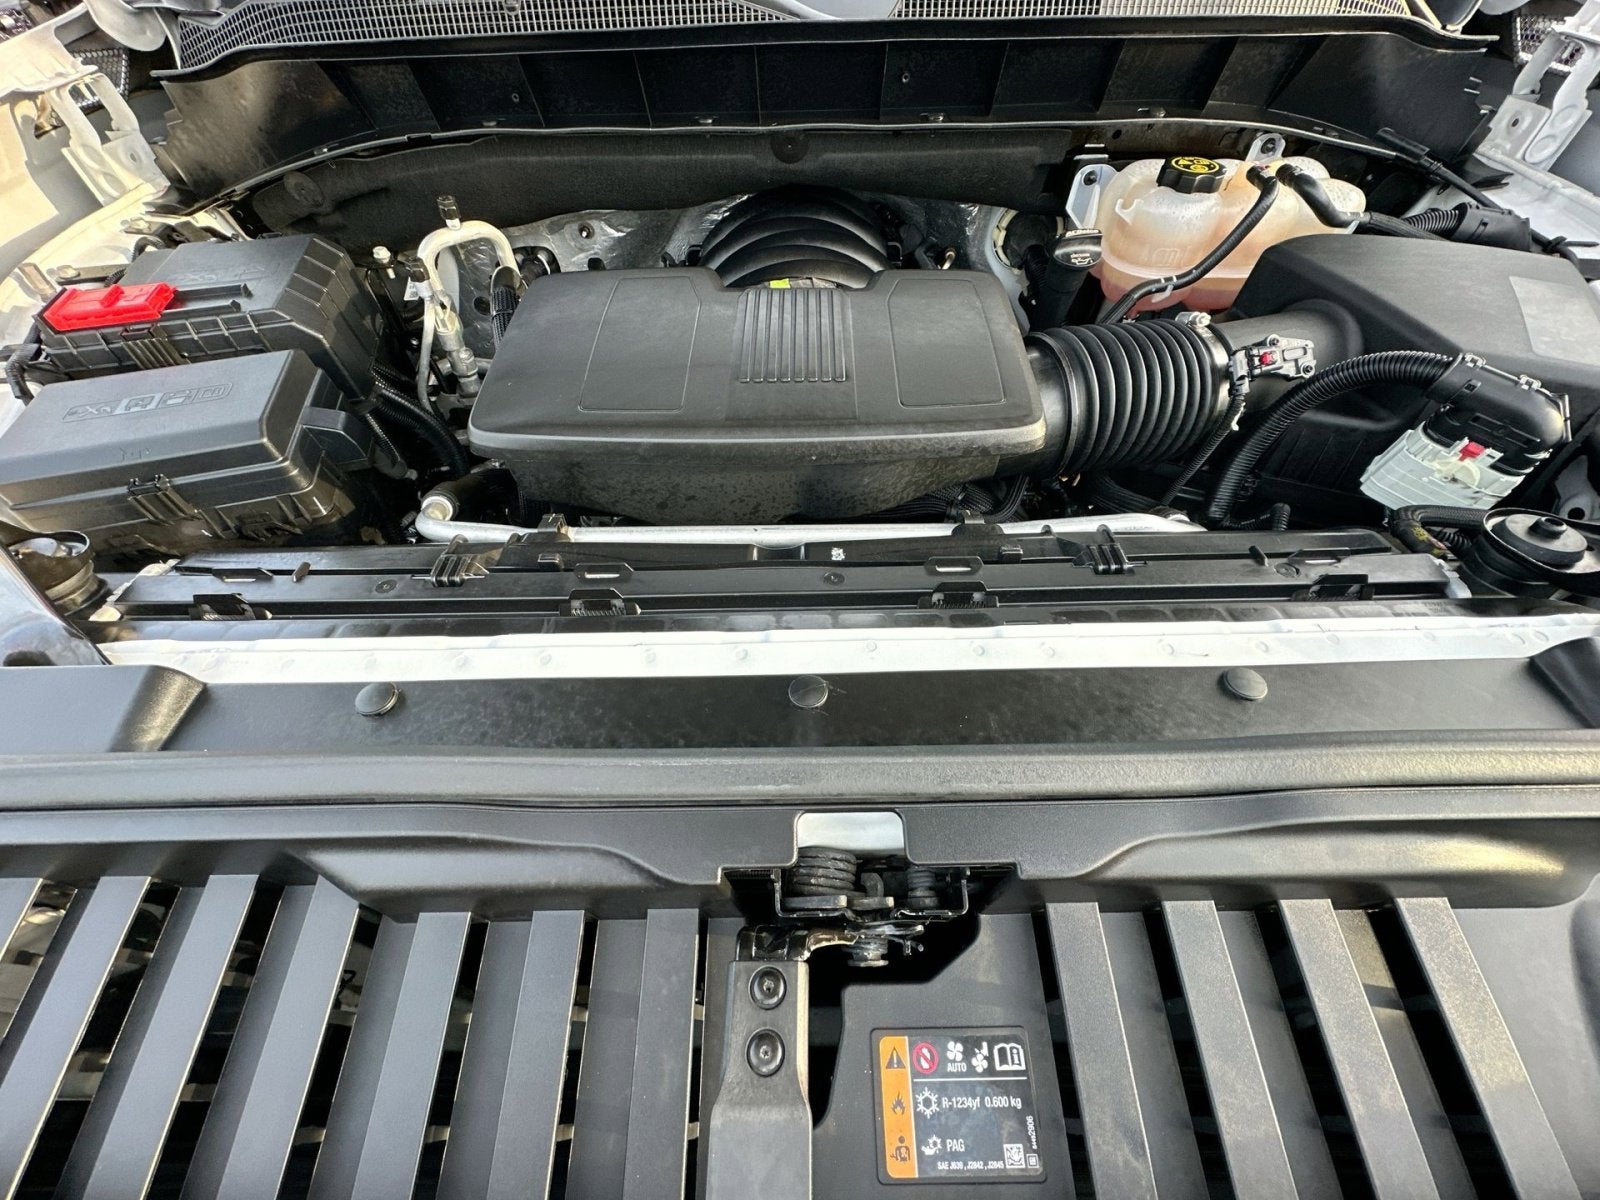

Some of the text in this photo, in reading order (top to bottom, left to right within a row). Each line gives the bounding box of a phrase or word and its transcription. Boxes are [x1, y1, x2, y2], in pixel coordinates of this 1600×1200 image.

[947, 1062, 967, 1072] AUTO
[942, 1096, 1022, 1110] R-1234yf 0.600 kg
[947, 1138, 965, 1152] PAG
[937, 1161, 949, 1170] SAE
